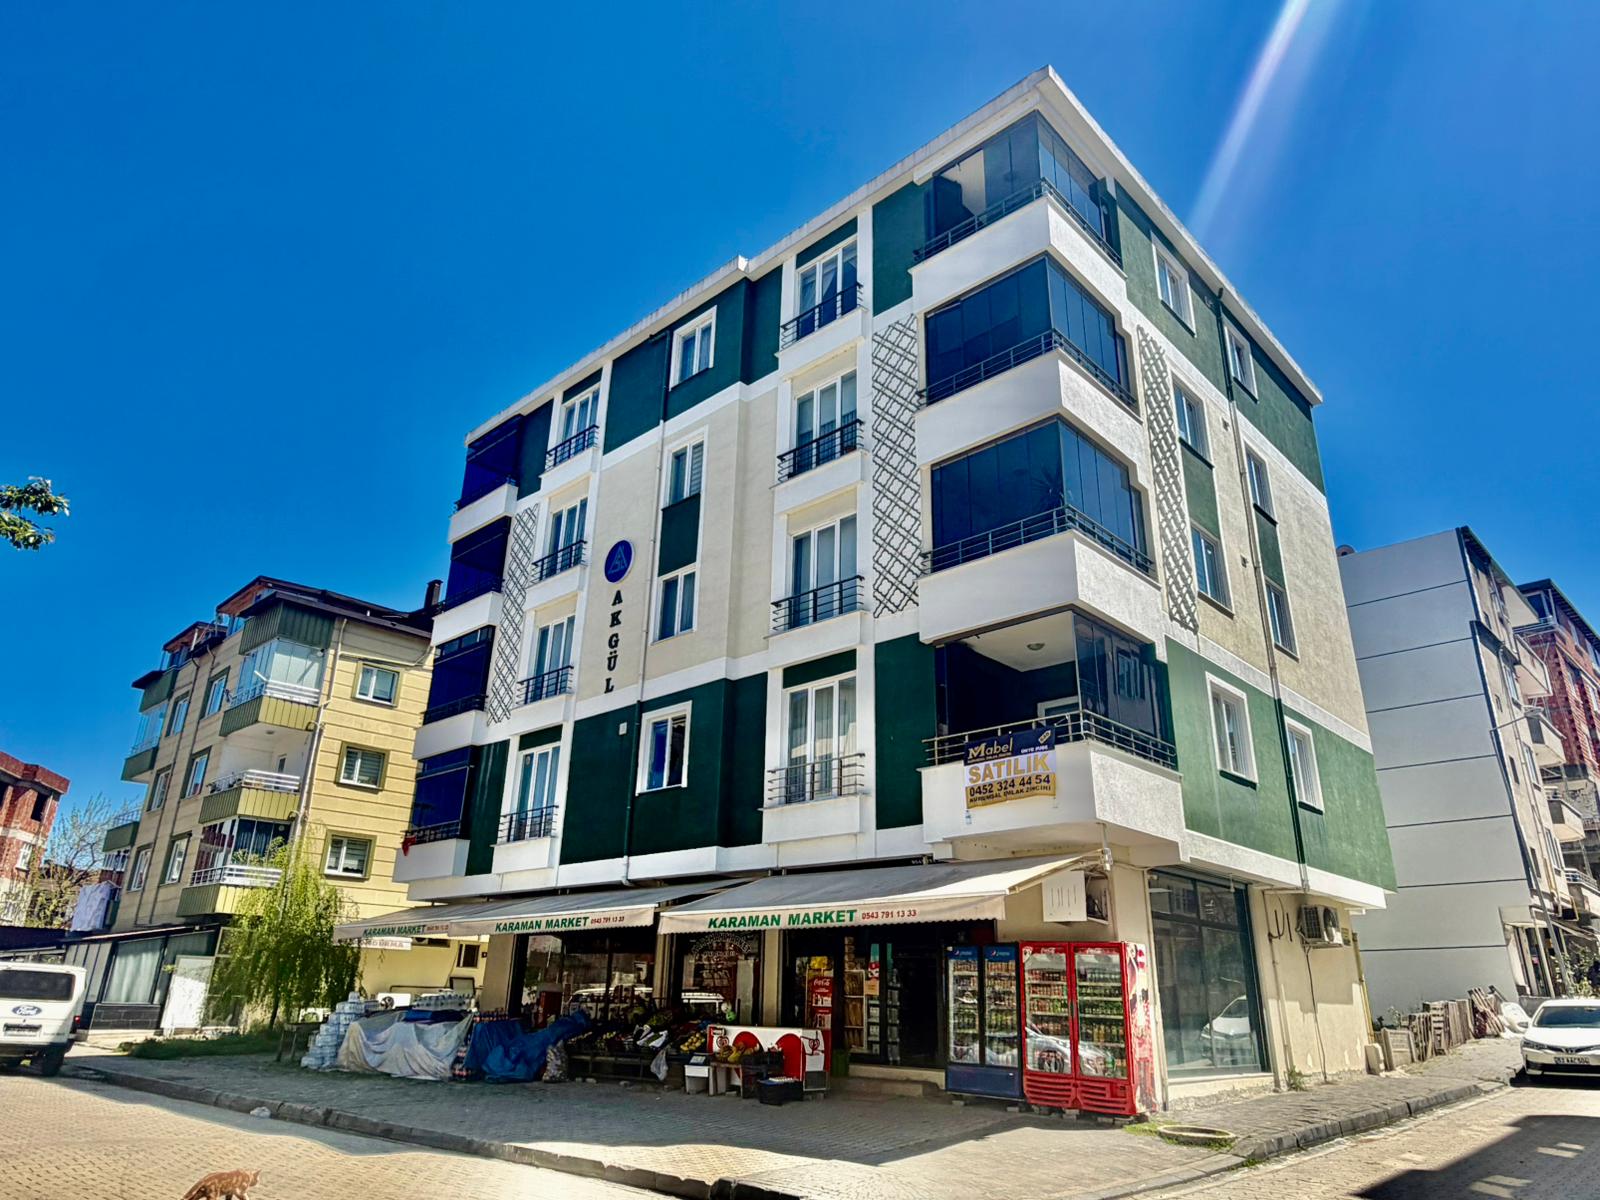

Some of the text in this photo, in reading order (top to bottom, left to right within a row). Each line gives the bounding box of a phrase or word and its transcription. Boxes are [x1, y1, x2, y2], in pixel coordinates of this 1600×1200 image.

[604, 590, 623, 694] AKGÜL
[967, 737, 1013, 760] Mabel
[968, 753, 1051, 784] SATILIK
[969, 774, 1051, 797] 0452 324 44 54
[363, 926, 396, 937] KARAMAN
[396, 924, 427, 935] MARKET
[495, 919, 542, 932] KARAMAN
[544, 916, 590, 929] MARKET
[708, 909, 917, 929] KARAMAN MARKET 0543 791 13 33
